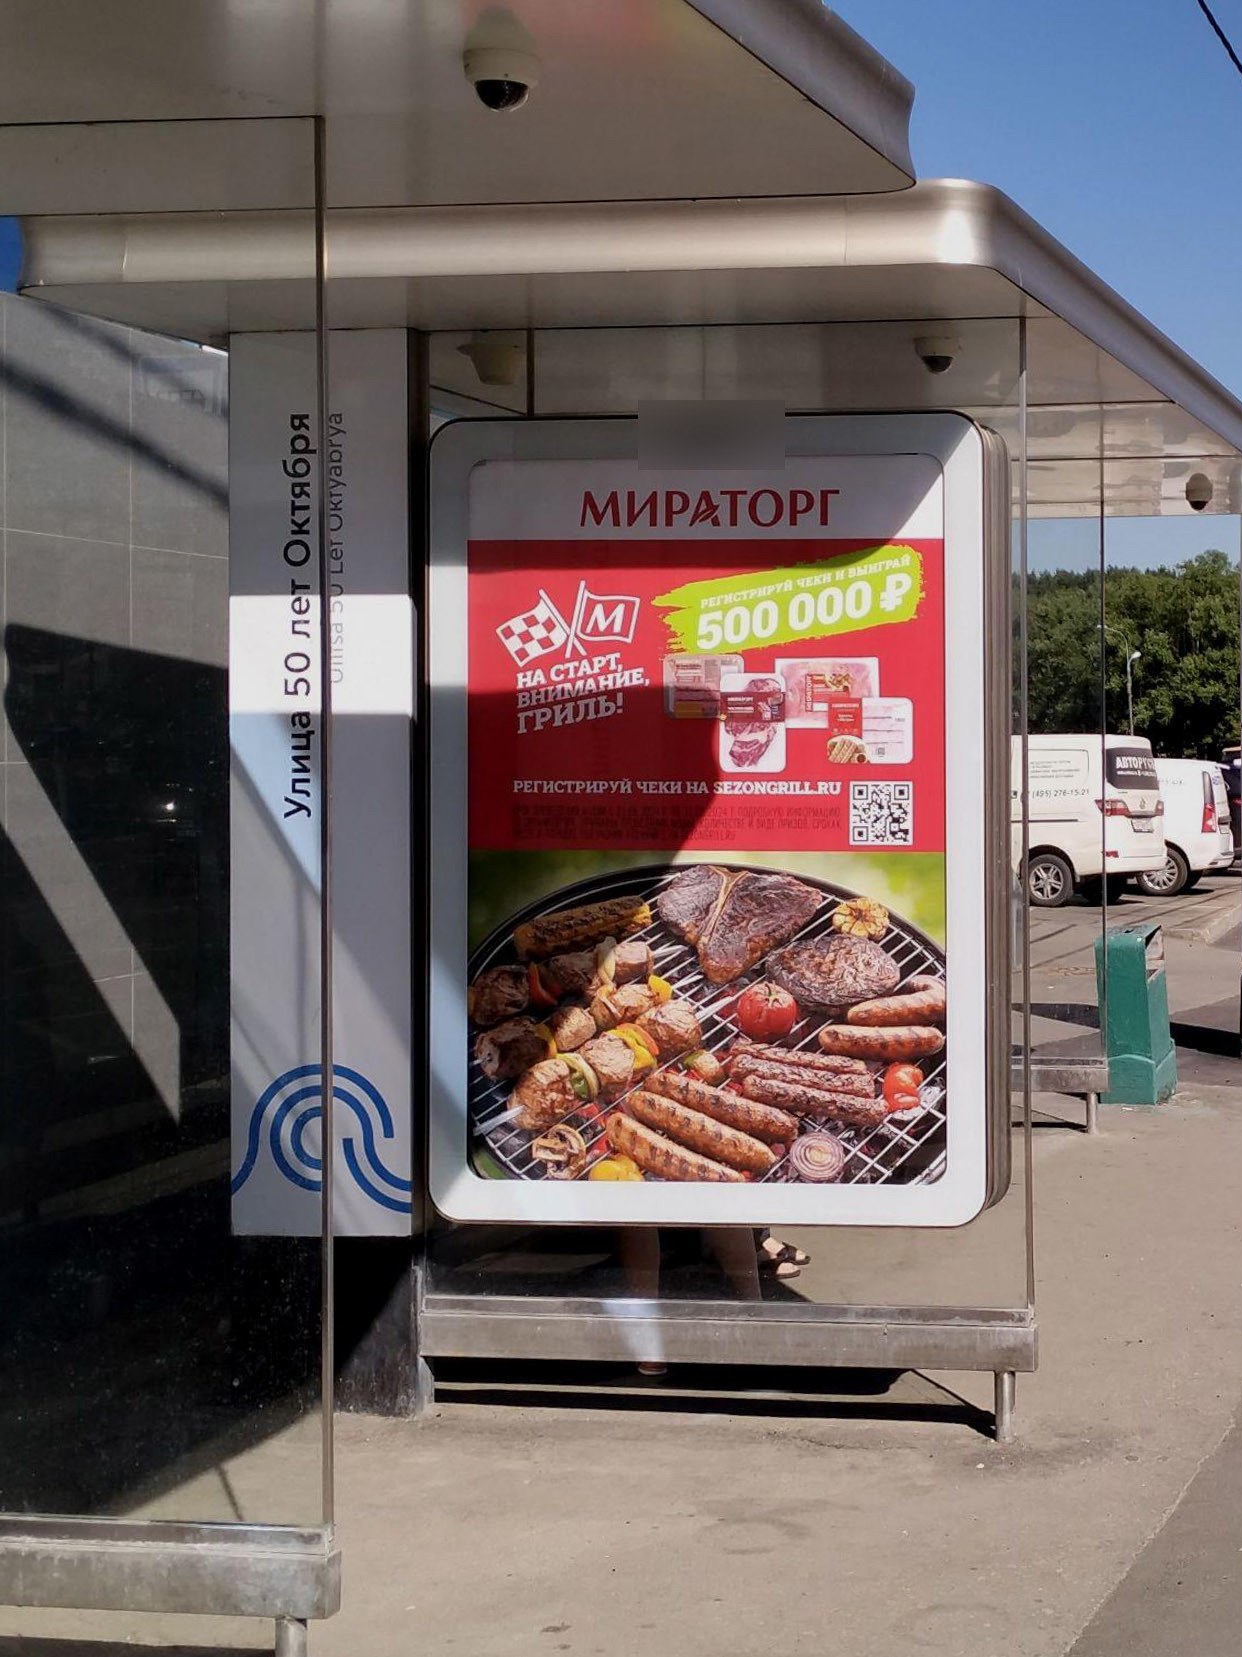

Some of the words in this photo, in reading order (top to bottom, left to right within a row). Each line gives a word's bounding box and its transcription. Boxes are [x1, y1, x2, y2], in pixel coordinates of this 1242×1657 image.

[282, 413, 317, 567] Октября
[580, 489, 840, 527] МИРАТОРГ
[700, 579, 793, 609] РЕГИСТРИРУЙ
[796, 572, 832, 589] ЧЕКИ
[835, 570, 844, 581] И
[848, 554, 912, 578] ВЫИГРАЙ
[288, 579, 311, 639] лет
[696, 600, 778, 650] 500
[788, 580, 872, 631] 000
[283, 652, 311, 697] 50
[516, 669, 548, 690] НА
[550, 652, 623, 682] СТАРТ,
[517, 667, 650, 709] ВНИМАНИЕ,
[517, 692, 624, 734] ГРИЛЬ!
[283, 712, 316, 818] Улица
[513, 778, 633, 794] РЕГИСТРИРУЙ
[636, 781, 682, 794] ЧЕКИ
[686, 781, 709, 794] НА
[713, 781, 842, 795] SEZONGRILL.RU
